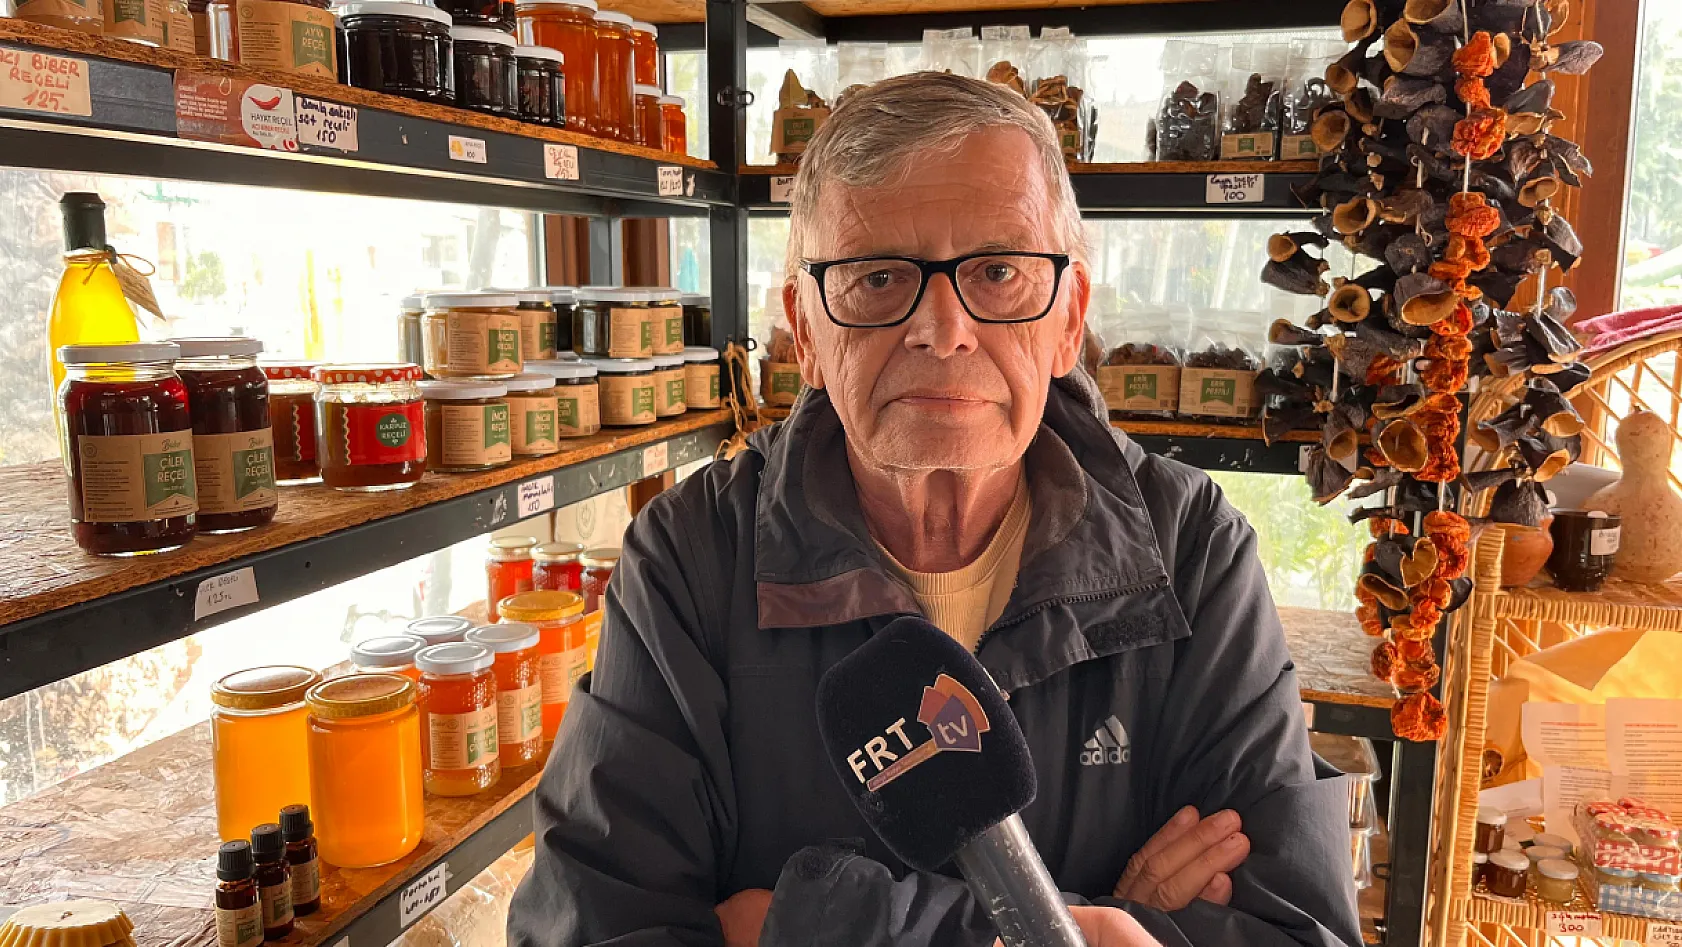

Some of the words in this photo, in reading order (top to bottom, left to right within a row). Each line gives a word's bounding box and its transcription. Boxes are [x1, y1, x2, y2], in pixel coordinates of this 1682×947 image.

[251, 112, 271, 124] HAYAT
[316, 130, 337, 144] 150
[1224, 191, 1246, 202] 100
[160, 454, 185, 471] ÇİLEK
[157, 468, 188, 483] REÇELİ
[847, 717, 913, 785] FRT
[936, 715, 969, 745] tv
[1559, 923, 1585, 933] 300
